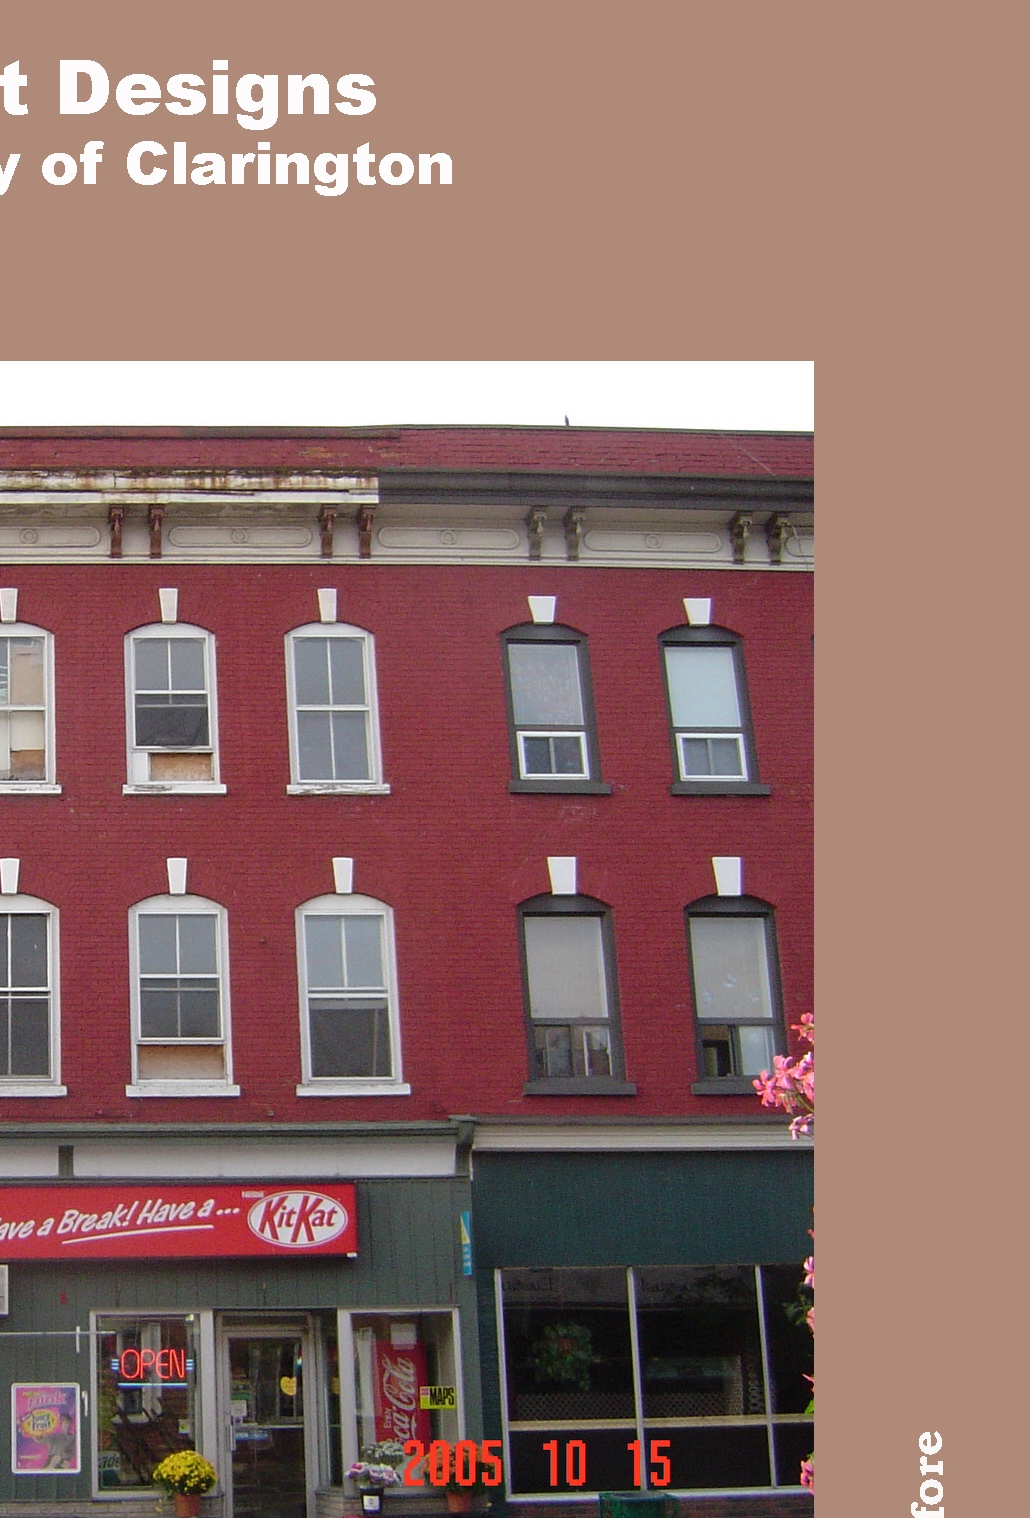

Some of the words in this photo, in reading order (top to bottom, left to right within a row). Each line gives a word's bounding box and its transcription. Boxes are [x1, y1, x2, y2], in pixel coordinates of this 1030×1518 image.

[36, 1221, 53, 1237] a
[56, 1201, 135, 1235] Break!
[137, 1198, 196, 1225] Have
[120, 1349, 186, 1380] OPEN
[429, 1387, 455, 1406] MAPS
